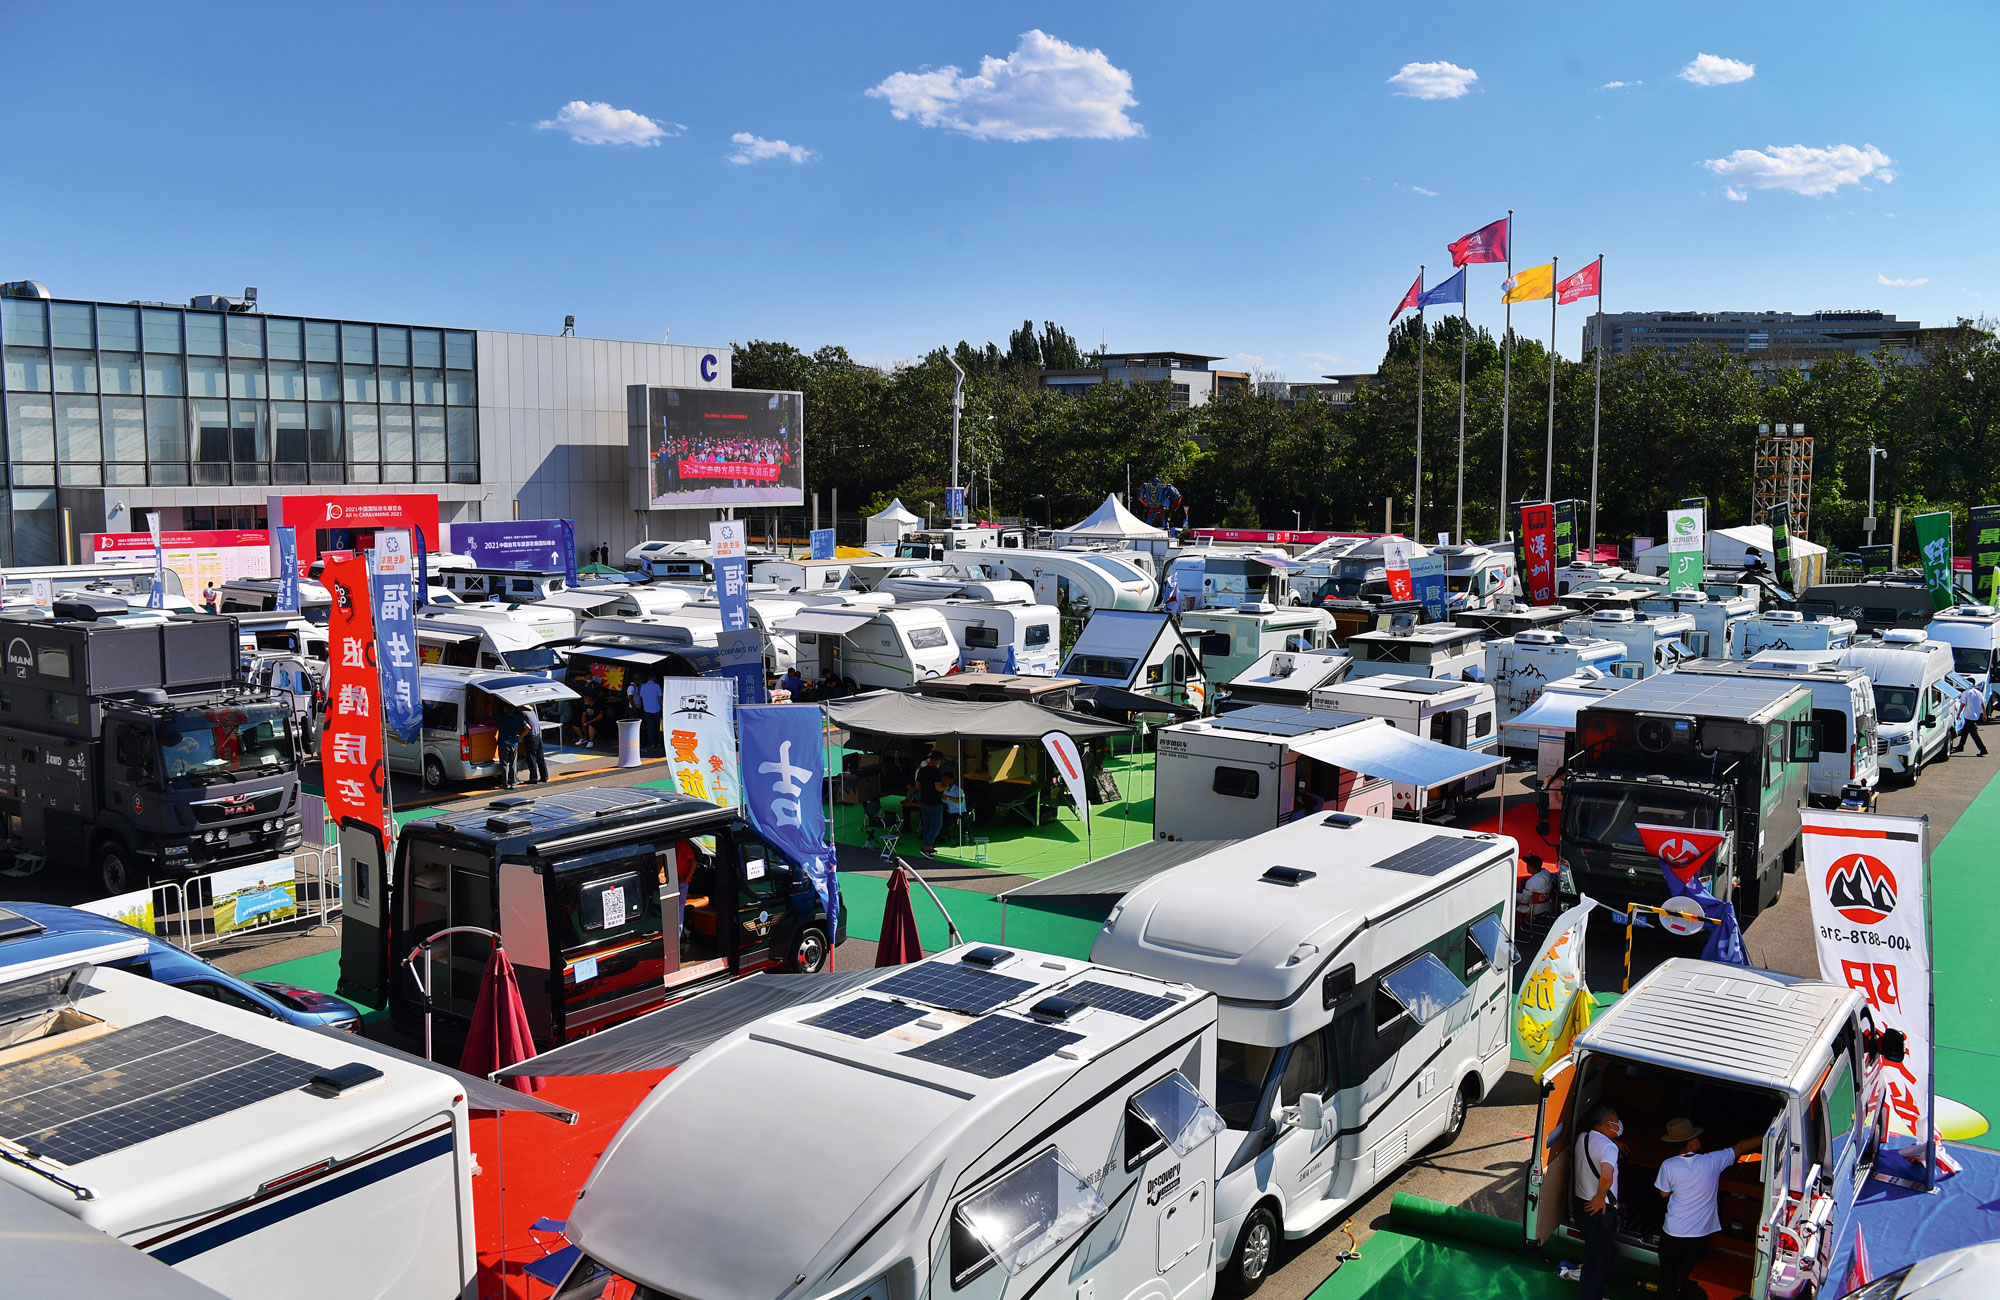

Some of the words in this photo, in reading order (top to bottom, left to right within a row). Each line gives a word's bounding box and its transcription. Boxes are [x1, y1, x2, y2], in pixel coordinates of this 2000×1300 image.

[701, 353, 717, 382] C
[9, 654, 32, 667] MAN
[224, 803, 255, 815] MAN
[1147, 1162, 1181, 1194] Discovery
